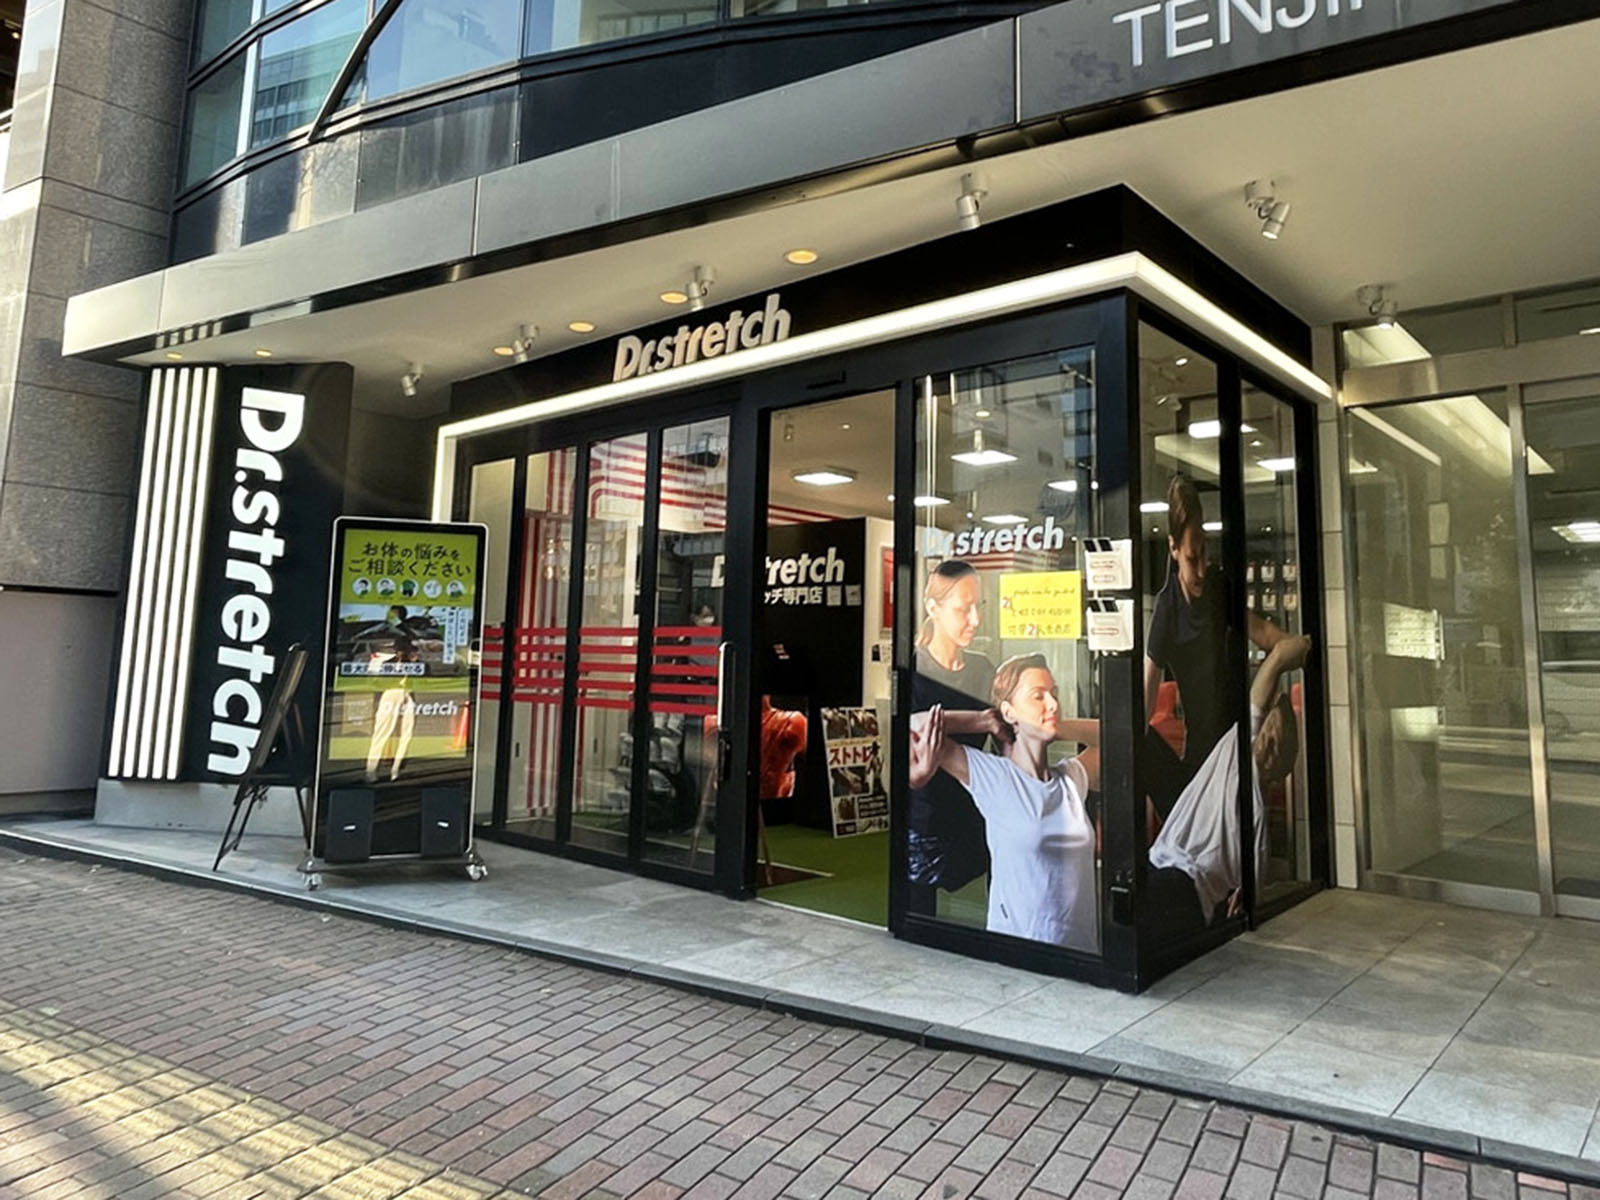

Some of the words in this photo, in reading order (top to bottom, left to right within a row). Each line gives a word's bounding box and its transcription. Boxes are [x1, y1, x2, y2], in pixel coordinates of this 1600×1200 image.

[1112, 0, 1363, 66] TENJ
[612, 293, 791, 382] Dr.stretch
[207, 386, 306, 777] Dr.stretch
[348, 557, 472, 578] ご相談ください
[362, 541, 461, 560] お体の悩みを
